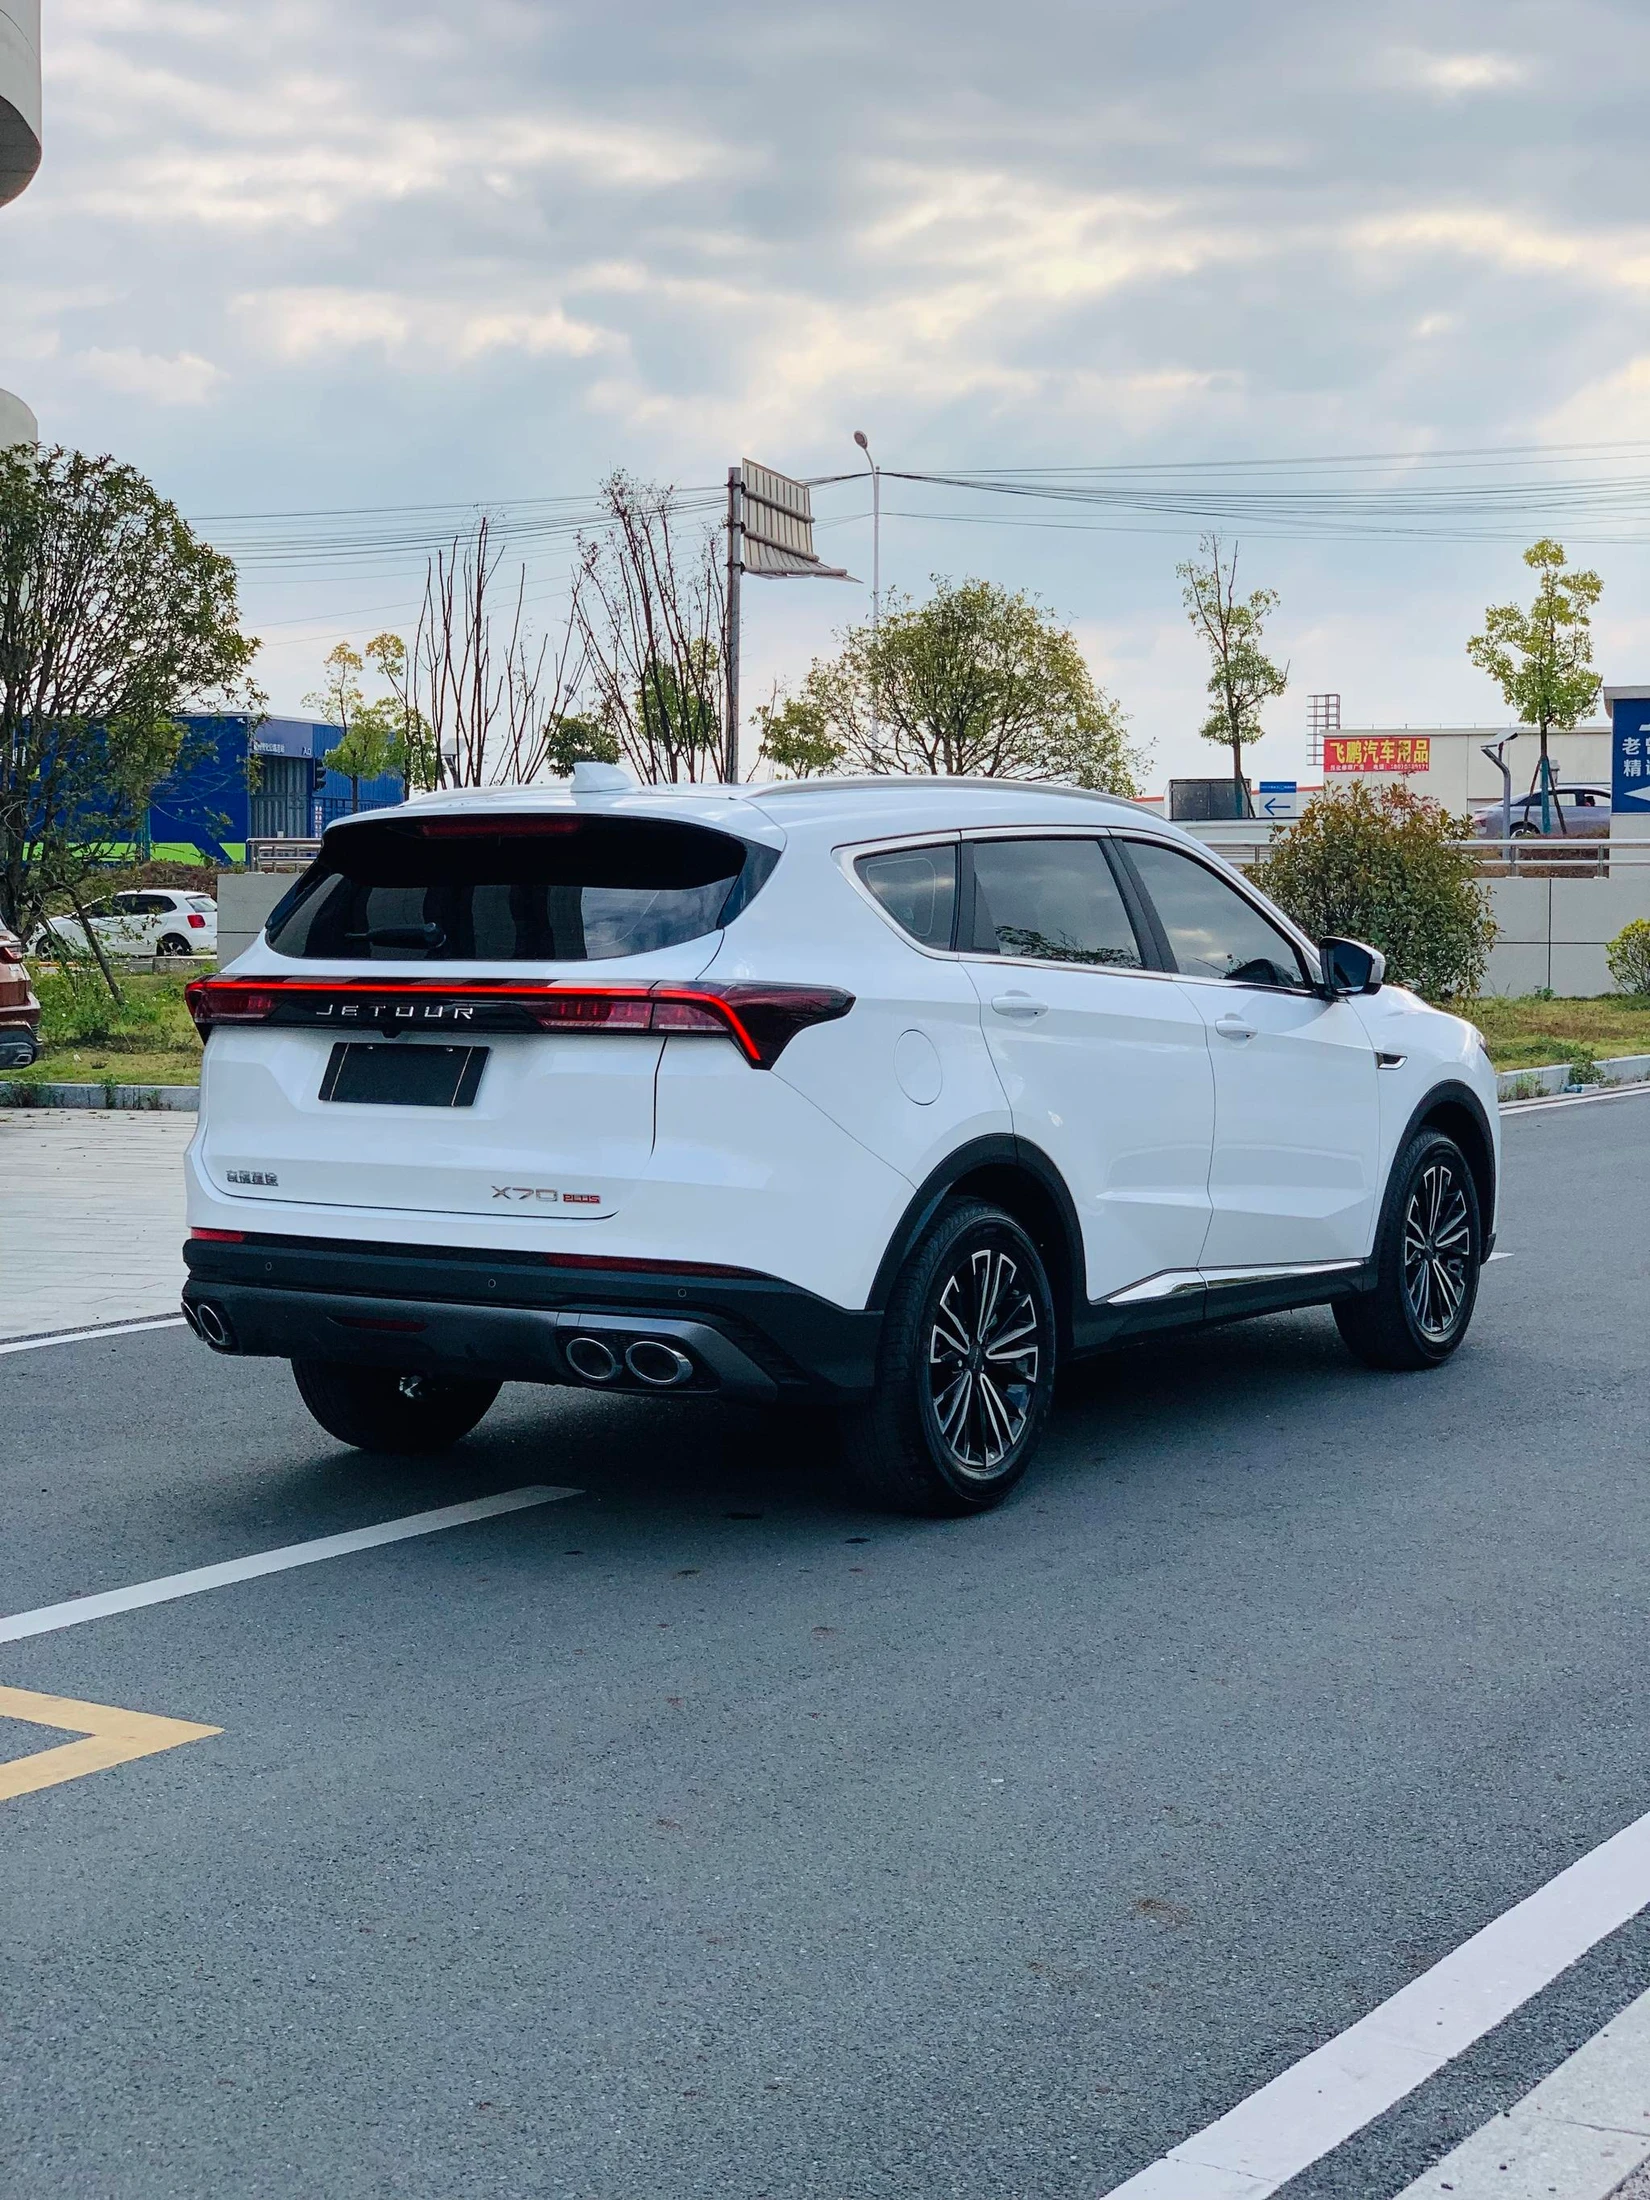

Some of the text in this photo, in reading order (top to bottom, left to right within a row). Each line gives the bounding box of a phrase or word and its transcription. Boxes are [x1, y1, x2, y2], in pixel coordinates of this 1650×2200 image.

[1329, 739, 1429, 764] 飞鹏汽车用品
[1622, 737, 1650, 756] 老
[1623, 759, 1650, 777] 精
[316, 1003, 474, 1020] JETOUR
[491, 1185, 601, 1205] X70 PLUS
